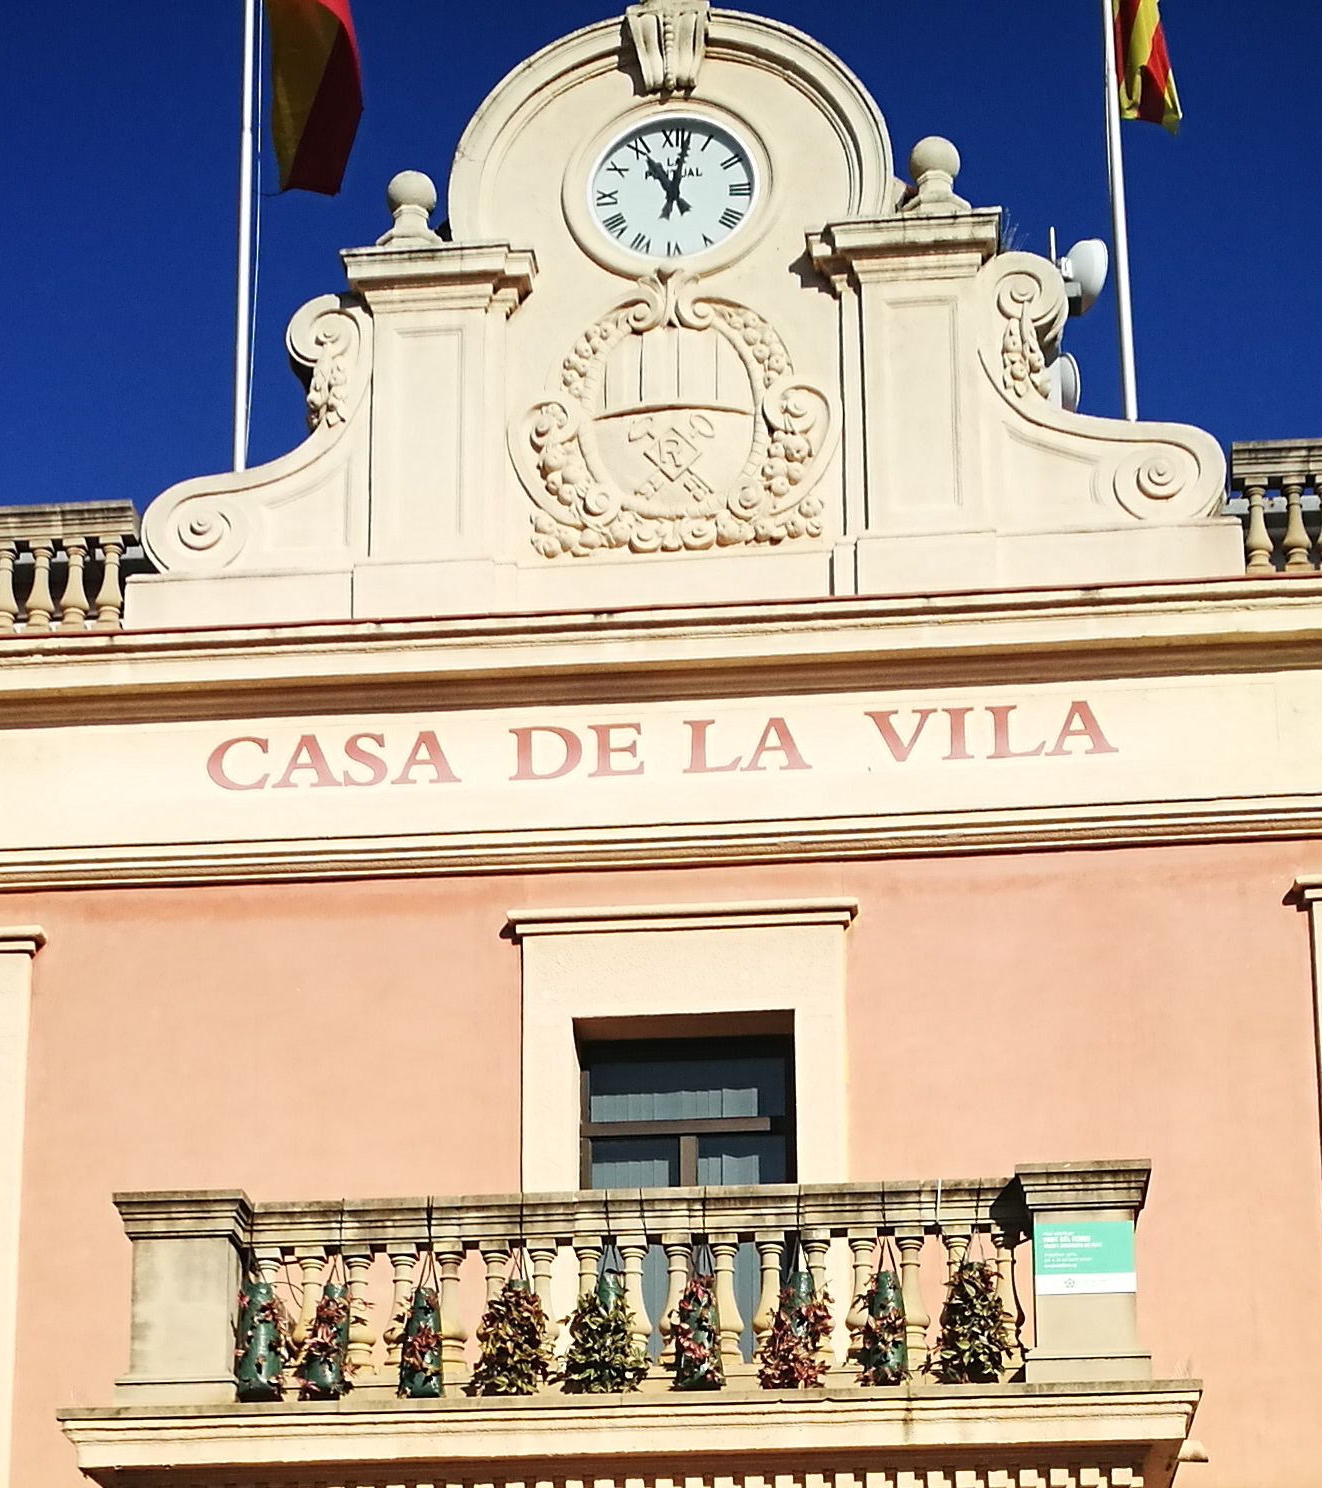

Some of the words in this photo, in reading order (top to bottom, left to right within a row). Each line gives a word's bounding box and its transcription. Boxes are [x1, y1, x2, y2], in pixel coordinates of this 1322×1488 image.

[206, 730, 462, 791] CASA
[508, 722, 646, 781] DE
[682, 716, 812, 775] LA
[864, 699, 1119, 763] VILA
